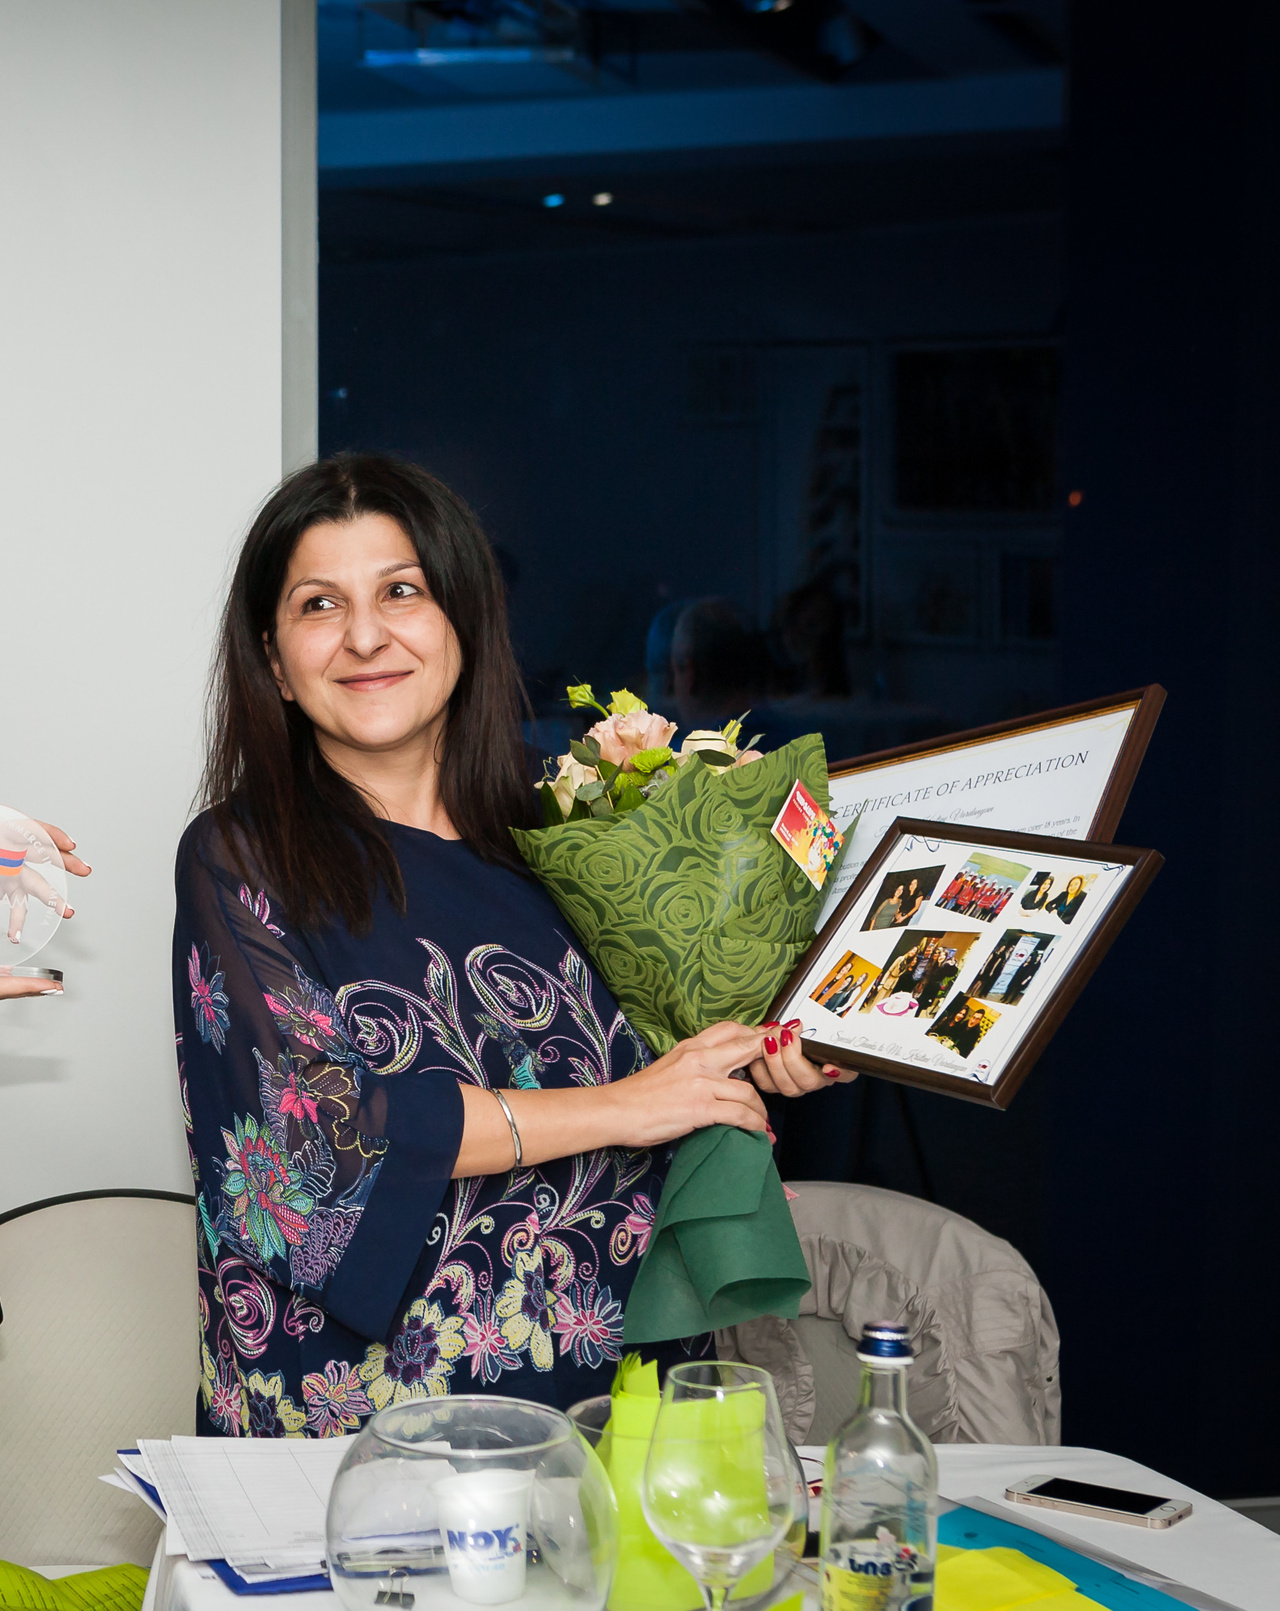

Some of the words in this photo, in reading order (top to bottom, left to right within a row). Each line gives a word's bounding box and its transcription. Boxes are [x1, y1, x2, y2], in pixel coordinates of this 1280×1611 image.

[833, 786, 934, 820] CERTIFICATE
[936, 780, 960, 797] OF
[961, 750, 1090, 792] APPRECIATION
[446, 1526, 514, 1552] NOY
